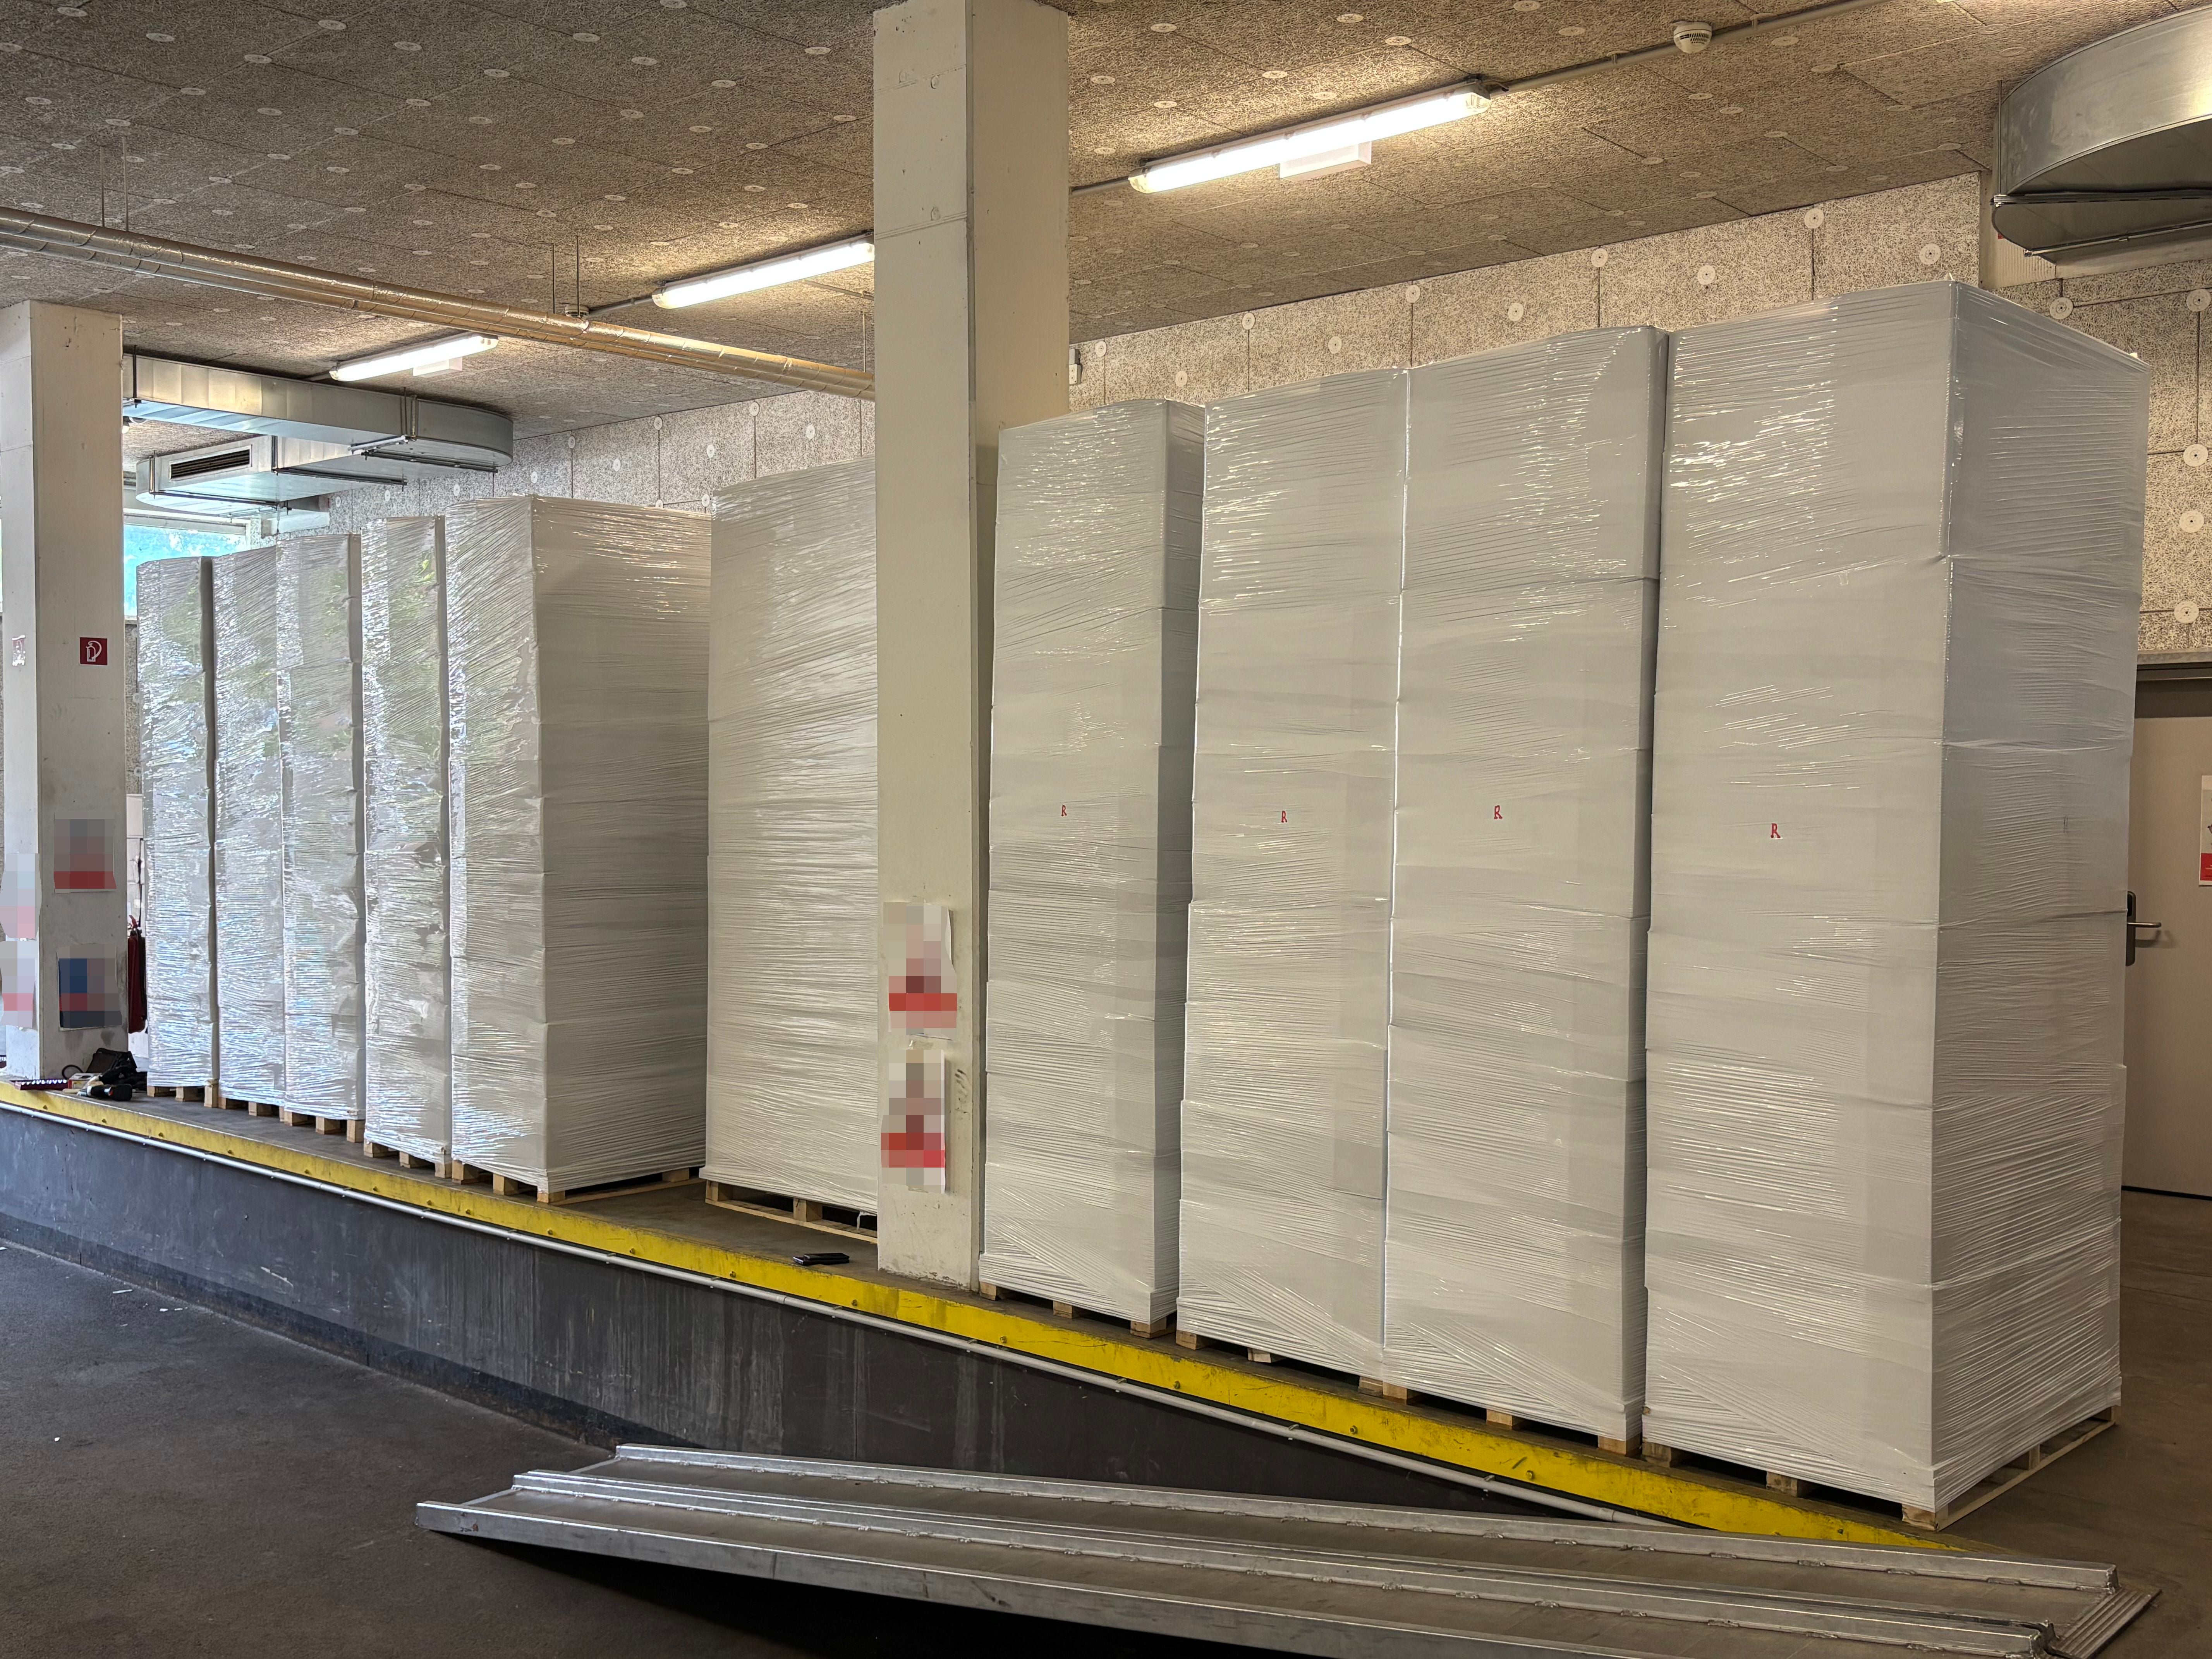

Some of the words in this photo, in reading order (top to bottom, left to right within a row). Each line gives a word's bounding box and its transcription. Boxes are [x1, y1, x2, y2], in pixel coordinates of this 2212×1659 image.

[1061, 804, 1067, 816] R
[1494, 805, 1503, 819] R
[1281, 811, 1287, 823] R
[1770, 823, 1781, 838] R
